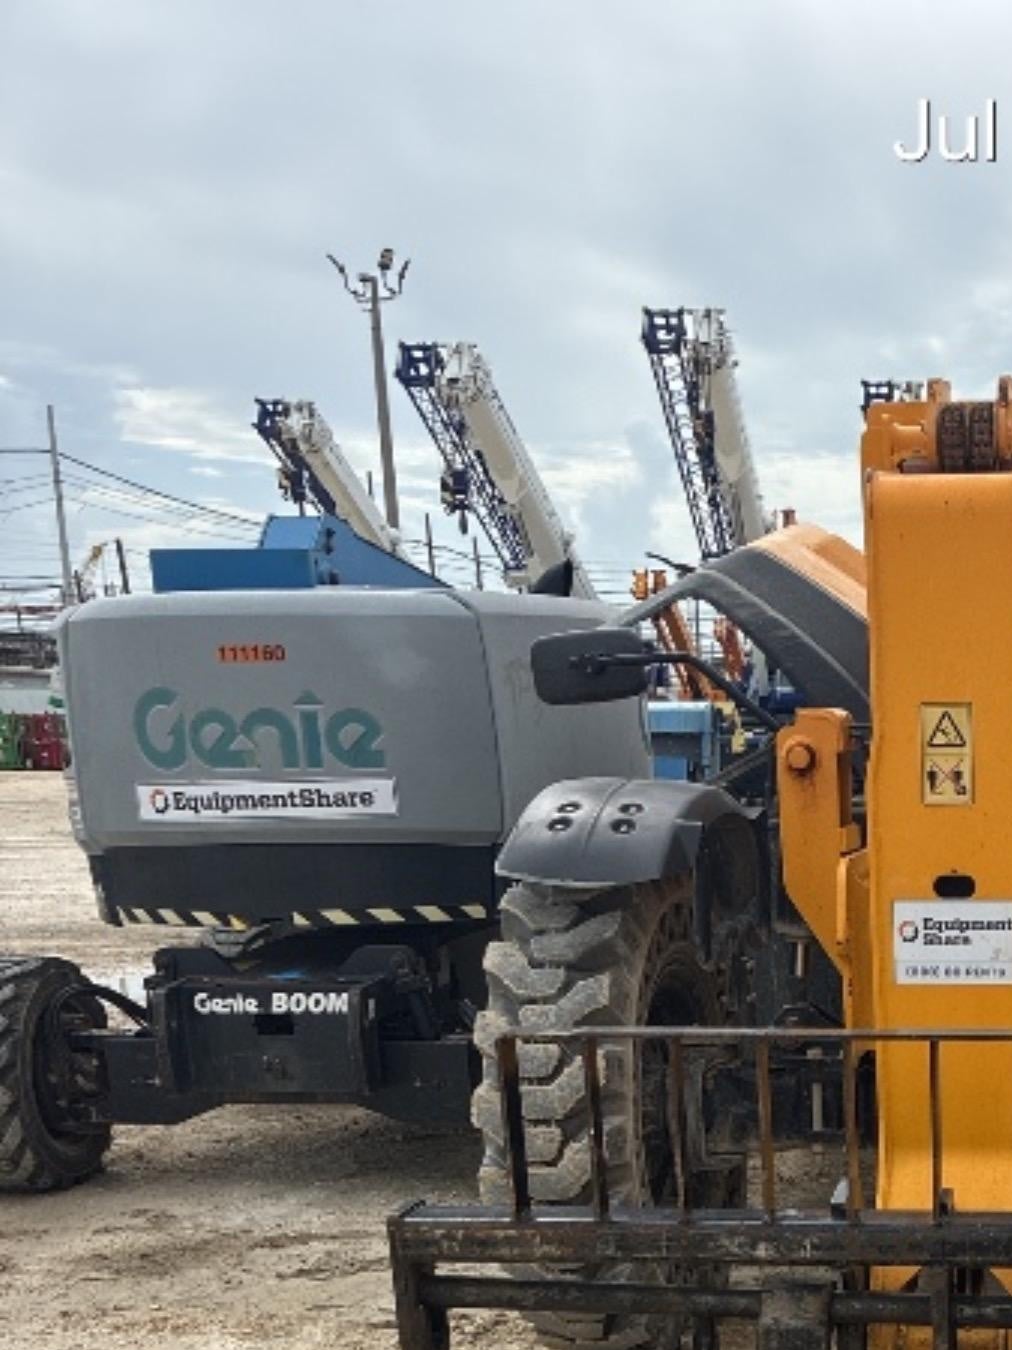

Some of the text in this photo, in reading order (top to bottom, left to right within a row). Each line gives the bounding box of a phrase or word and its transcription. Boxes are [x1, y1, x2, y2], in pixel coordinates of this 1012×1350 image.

[133, 686, 388, 771] Genie
[173, 788, 376, 814] EquipmentShare
[194, 992, 349, 1014] Genie BOOM
